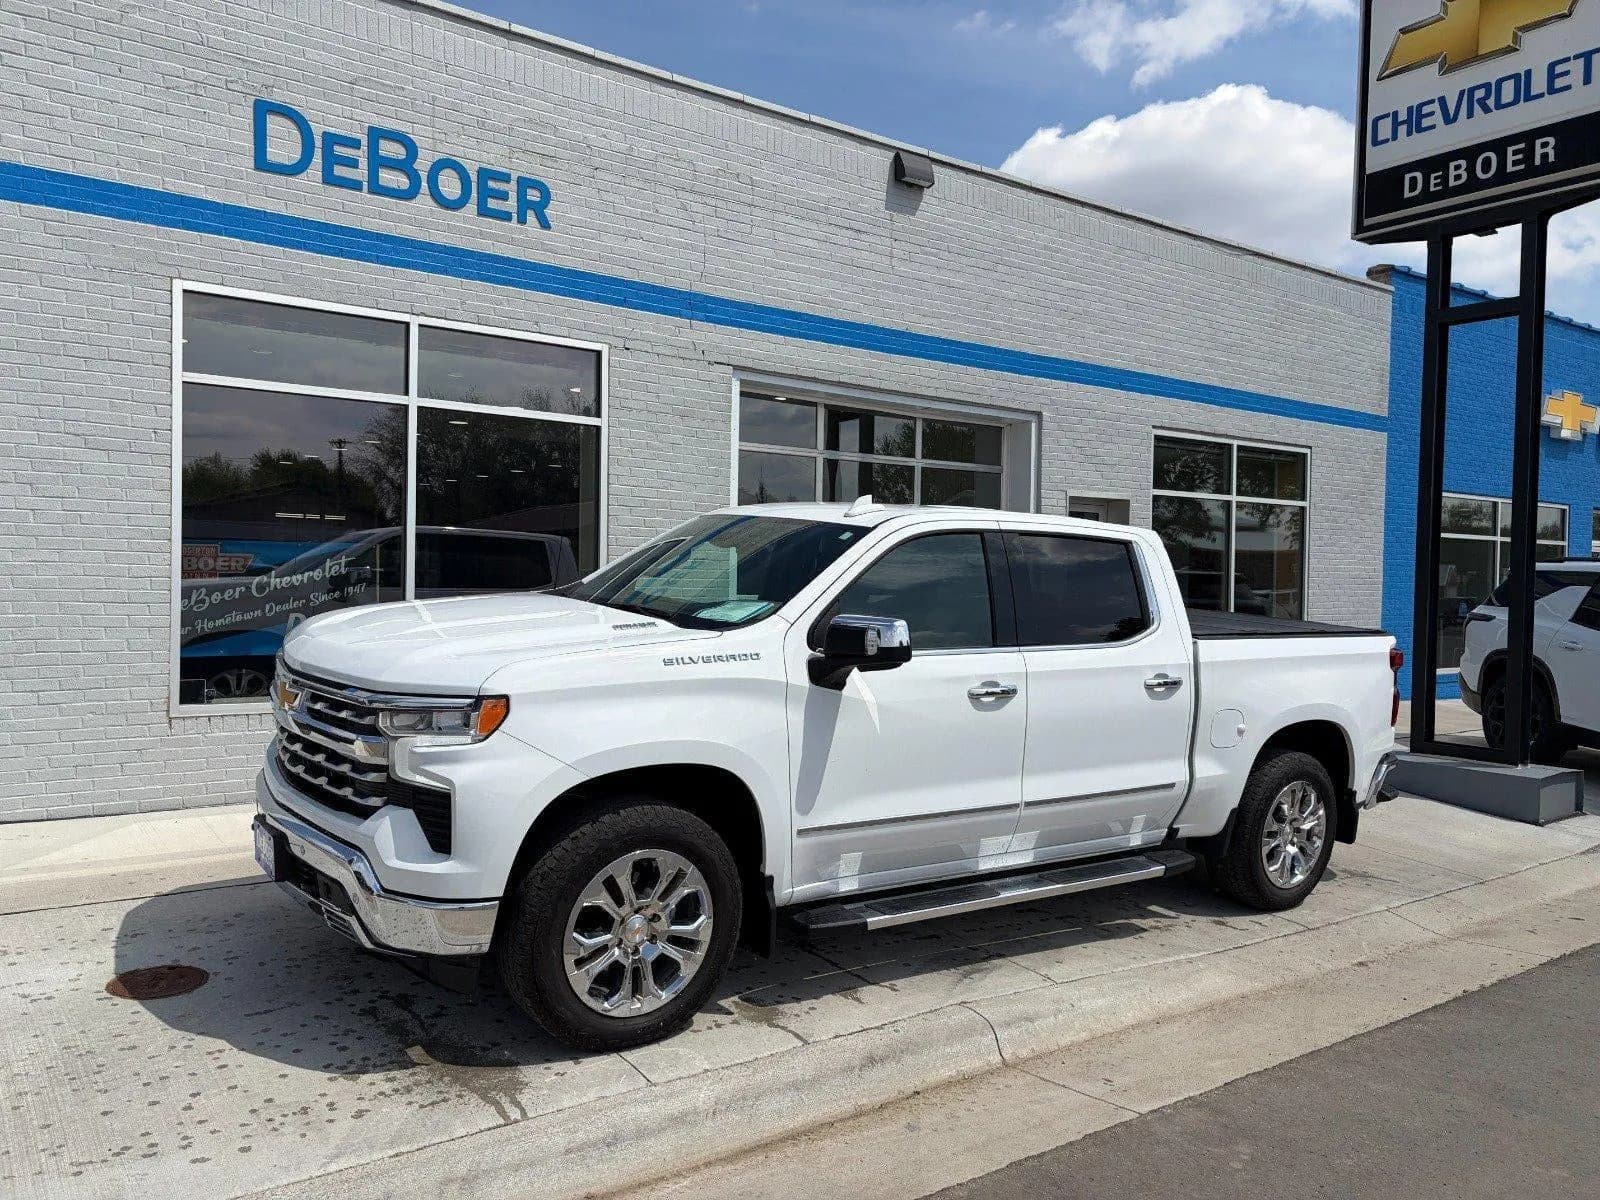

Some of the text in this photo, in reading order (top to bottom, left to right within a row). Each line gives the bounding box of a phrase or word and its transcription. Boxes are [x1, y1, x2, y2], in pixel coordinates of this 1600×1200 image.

[1371, 47, 1600, 147] CHEVROLET
[253, 98, 551, 229] DEBOER
[1403, 136, 1556, 199] DEBOER
[180, 627, 191, 635] ur
[195, 609, 261, 633] Hometown
[265, 597, 307, 617] Dealer
[309, 590, 341, 606] Since
[181, 555, 357, 611] eBoer Chevrolet
[662, 652, 762, 667] SILVERADO
